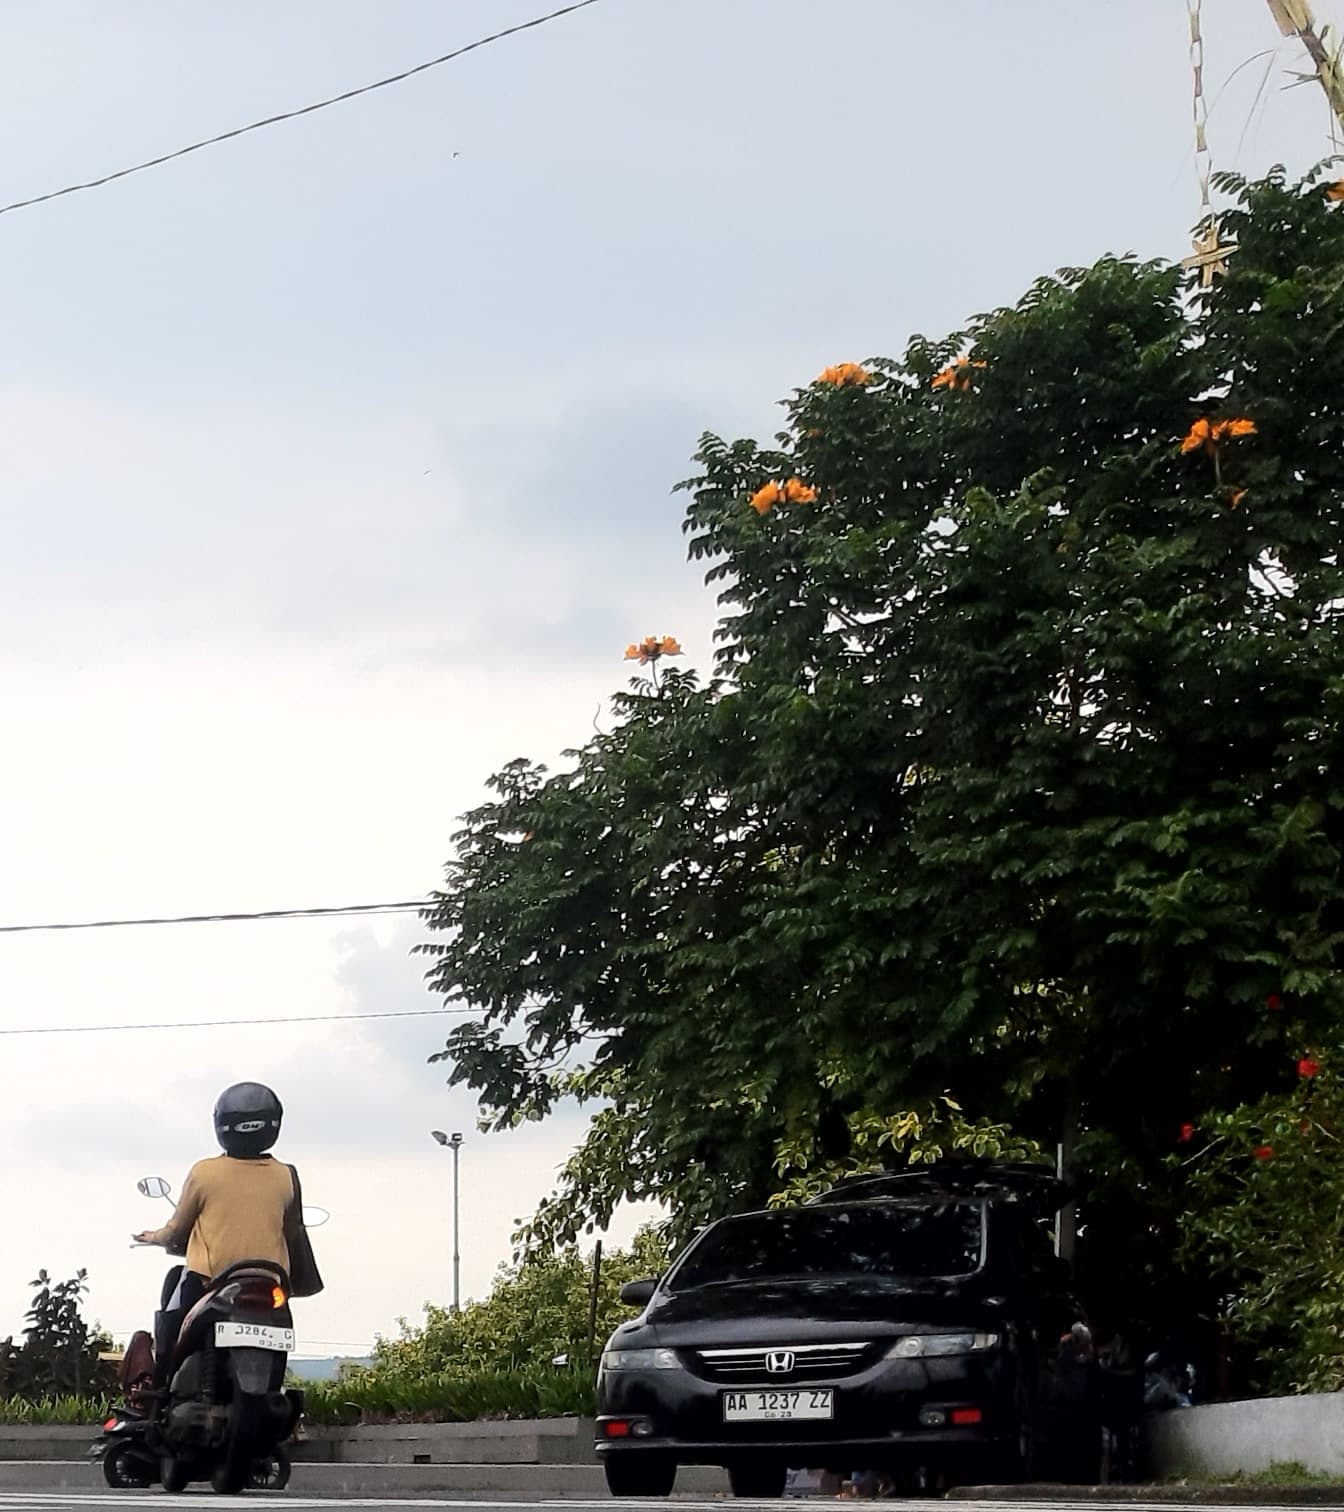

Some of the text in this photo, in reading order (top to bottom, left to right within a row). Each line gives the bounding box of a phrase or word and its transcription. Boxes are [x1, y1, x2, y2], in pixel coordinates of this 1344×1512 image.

[727, 1390, 830, 1410] AA 1237 ZZ
